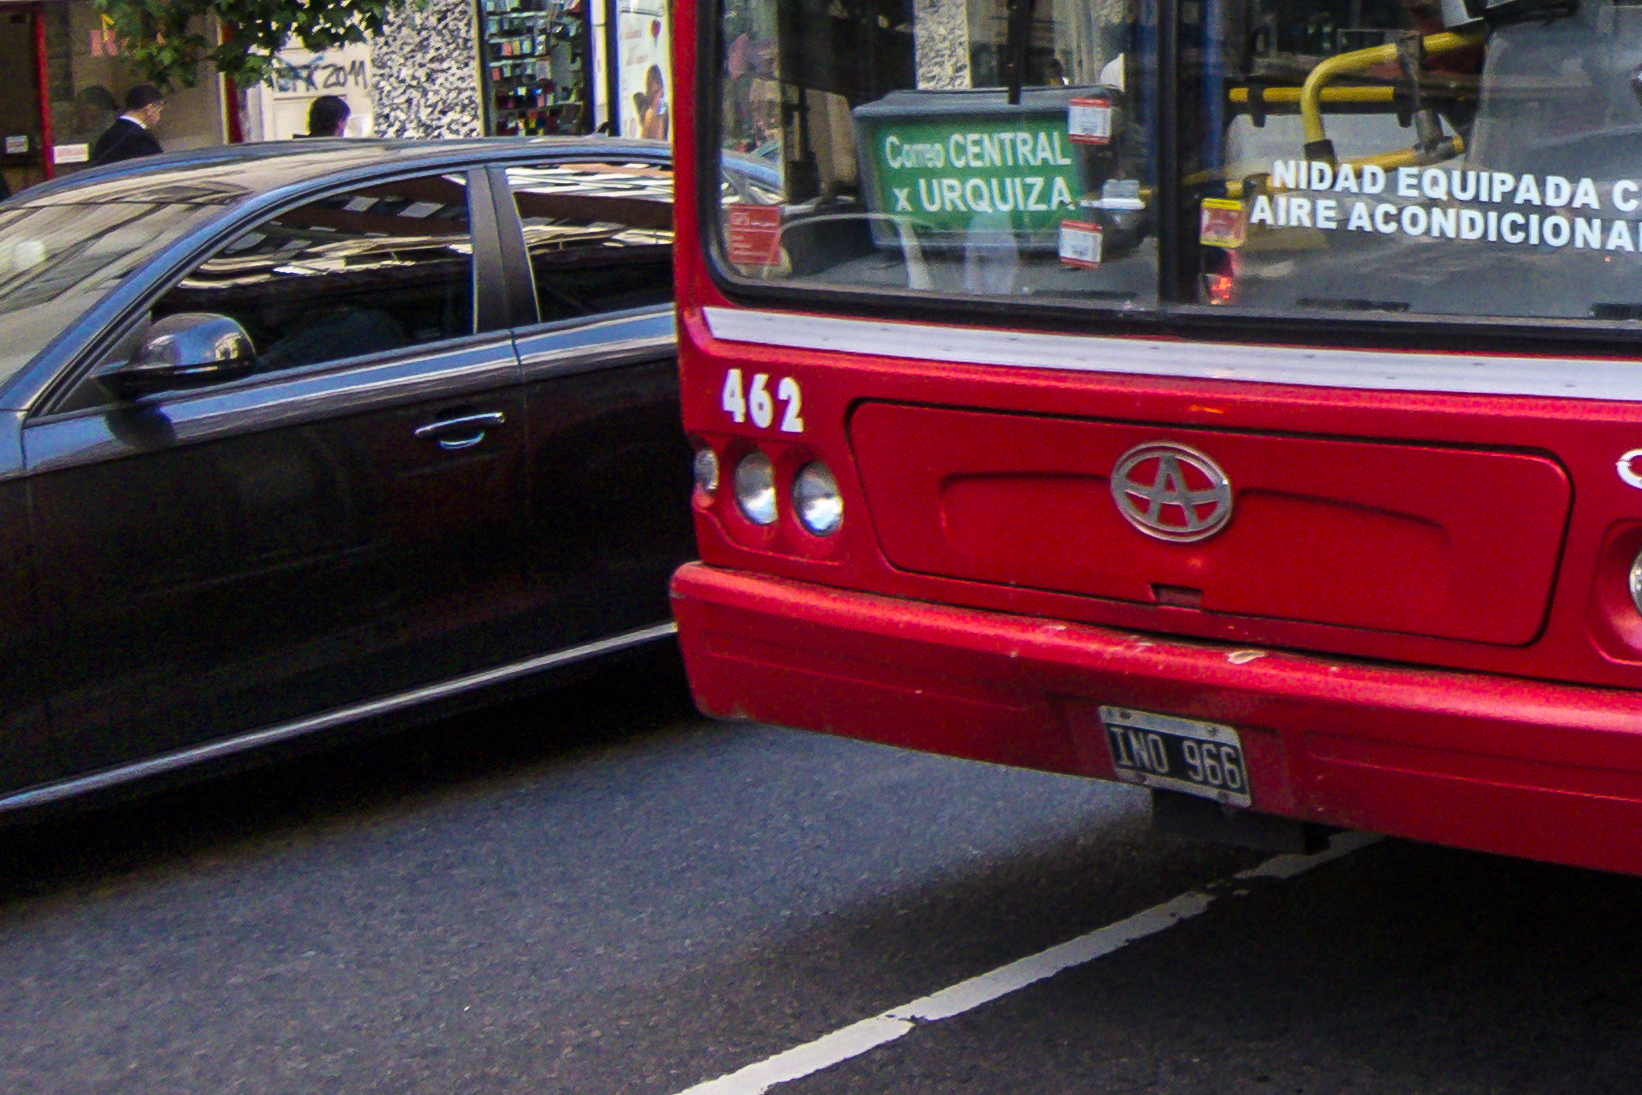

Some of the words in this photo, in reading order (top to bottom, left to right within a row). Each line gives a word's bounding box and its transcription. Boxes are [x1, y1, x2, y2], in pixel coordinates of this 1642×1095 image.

[949, 131, 1072, 169] CENTRAL
[918, 175, 1076, 214] URQUIZA
[1397, 166, 1601, 211] EQUIPADA
[1250, 194, 1338, 230] AIRE
[722, 368, 804, 433] 462
[1182, 739, 1242, 790] 966
